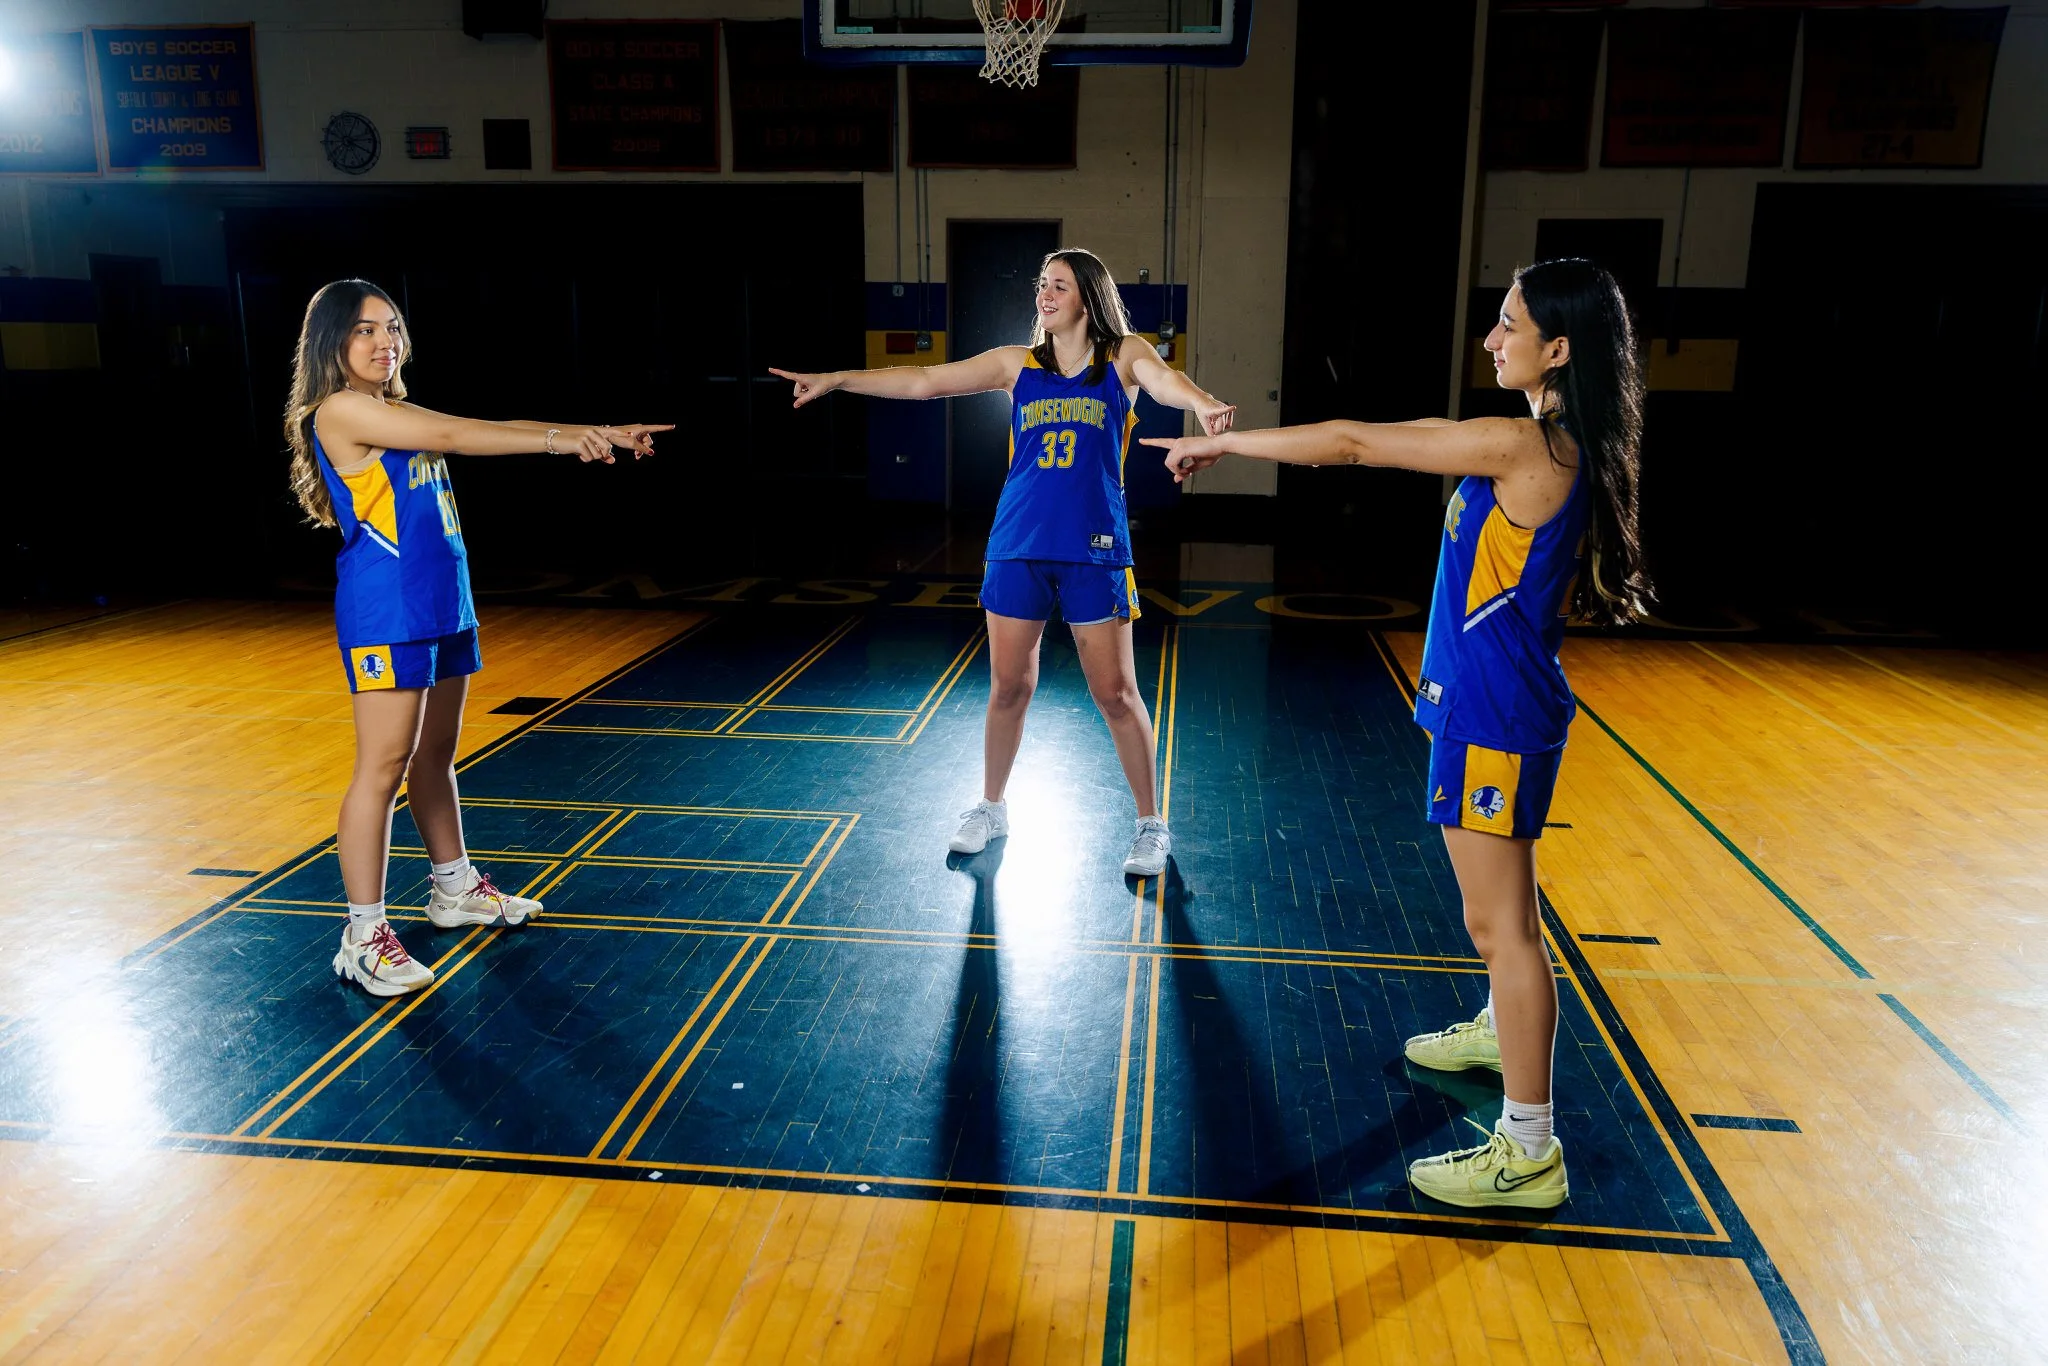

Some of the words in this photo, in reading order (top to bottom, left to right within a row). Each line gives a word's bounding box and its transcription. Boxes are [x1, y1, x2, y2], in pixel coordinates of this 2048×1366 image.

[109, 40, 158, 56] BOYS
[164, 40, 236, 55] SOCCER
[565, 40, 617, 59] BOYS
[623, 40, 701, 59] SOCCER
[130, 65, 202, 82] LEAGUE
[208, 65, 220, 80] V
[591, 73, 655, 91] CLASS
[620, 105, 703, 124] CHAMPIONS
[131, 116, 232, 134] CHAMPIONS
[160, 143, 207, 157] 2009
[1021, 396, 1107, 432] COMSEWOGUE
[1037, 429, 1077, 469] 33
